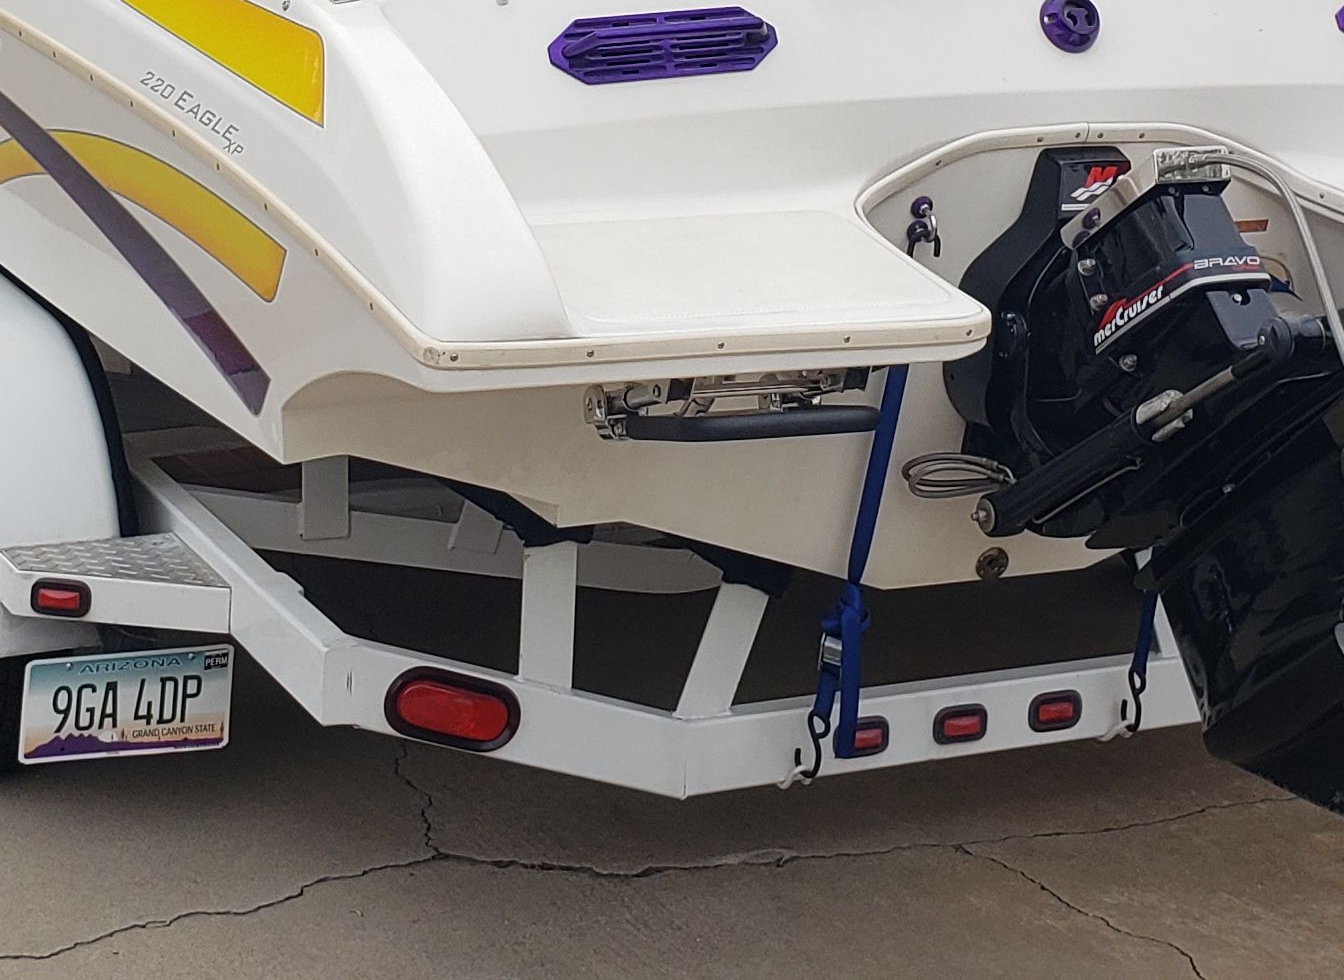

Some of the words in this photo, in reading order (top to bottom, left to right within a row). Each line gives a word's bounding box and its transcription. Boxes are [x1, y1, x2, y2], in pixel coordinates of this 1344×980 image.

[140, 71, 176, 100] 220
[174, 91, 239, 141] EAGLE
[223, 138, 244, 156] XP
[1194, 255, 1260, 269] BRAVO
[79, 657, 182, 674] ARIZONA
[206, 654, 228, 667] PERM
[52, 680, 119, 734] 9GA
[133, 674, 203, 726] 4DP
[132, 729, 160, 738] GRAND
[161, 726, 194, 736] CANYON
[194, 724, 216, 733] STATE
